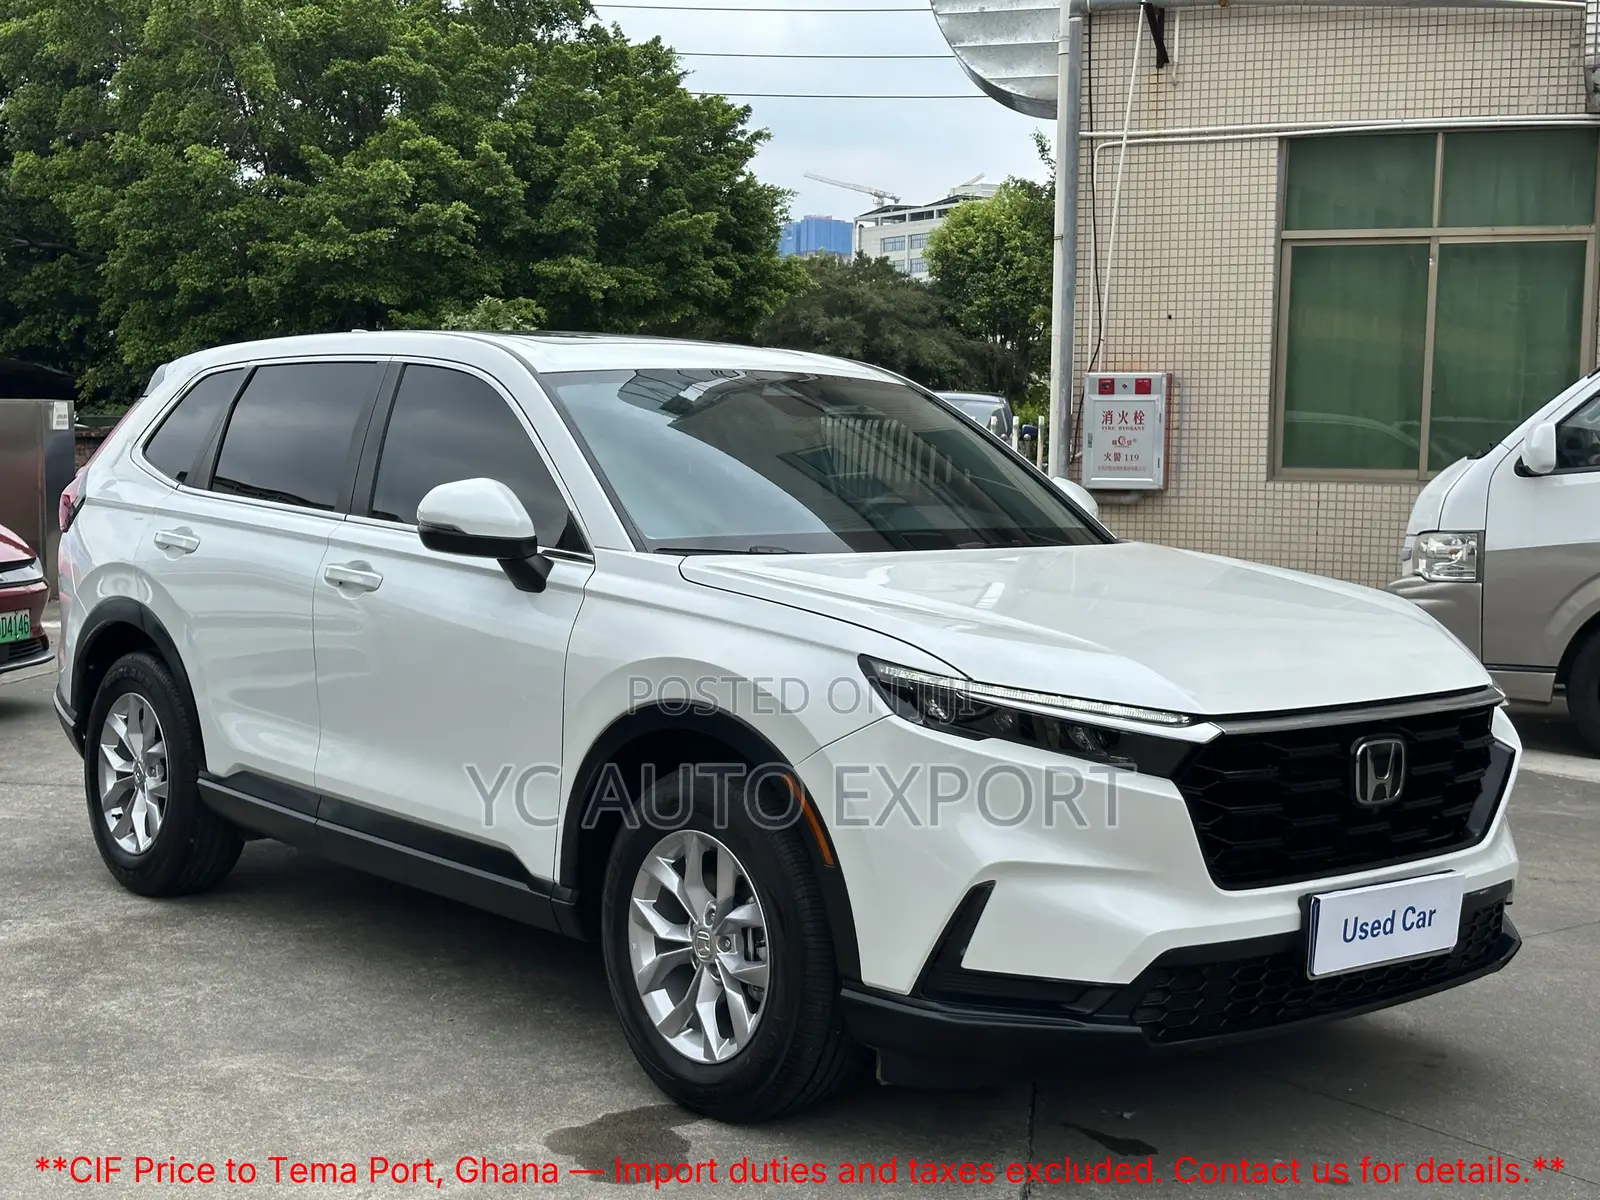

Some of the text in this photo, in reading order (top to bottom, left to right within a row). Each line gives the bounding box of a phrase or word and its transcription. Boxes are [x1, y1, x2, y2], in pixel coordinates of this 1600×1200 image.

[1101, 410, 1145, 425] 消火栓
[1124, 454, 1140, 462] 119
[0, 614, 30, 638] D4146
[1341, 905, 1437, 943] Used Car
